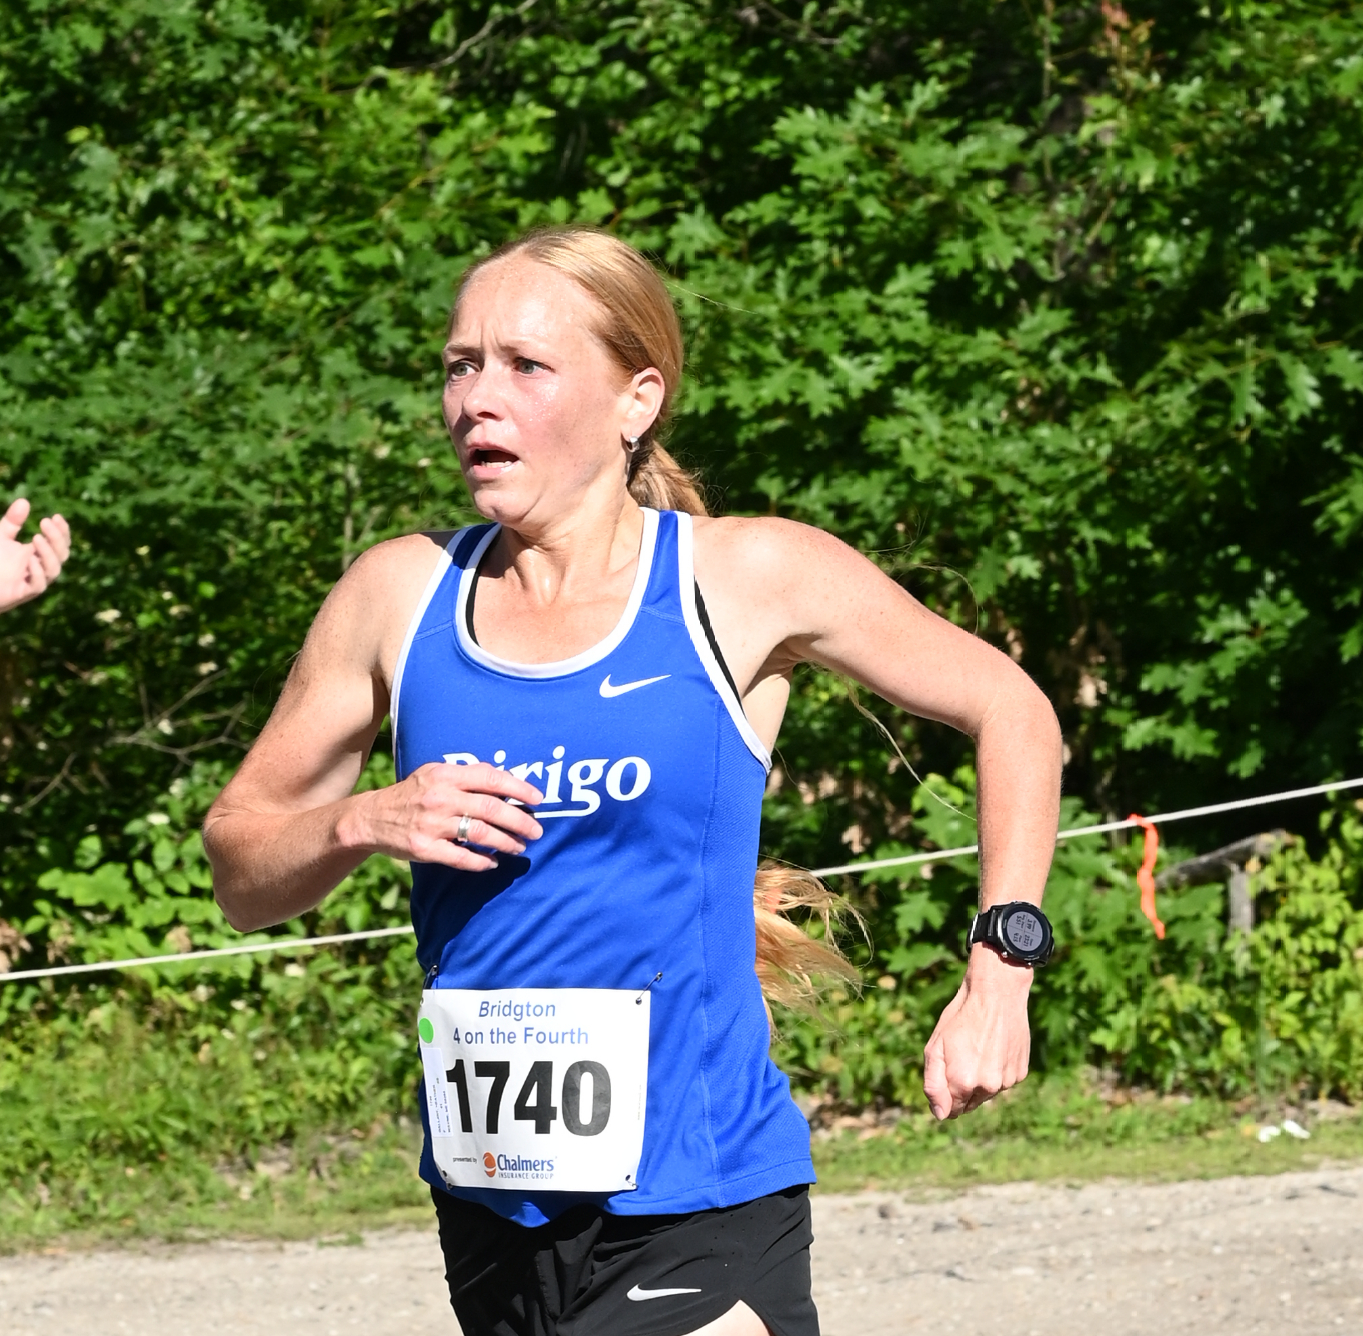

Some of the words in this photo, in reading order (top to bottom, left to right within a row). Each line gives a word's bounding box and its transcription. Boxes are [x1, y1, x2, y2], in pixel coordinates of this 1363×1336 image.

[441, 745, 652, 819] rigo
[478, 1000, 556, 1022] Bridgton
[453, 1027, 461, 1045] 4
[464, 1031, 484, 1045] on
[490, 1028, 517, 1045] the
[523, 1027, 589, 1045] Fourth
[446, 1059, 612, 1137] 1740
[497, 1153, 554, 1172] Chalmers
